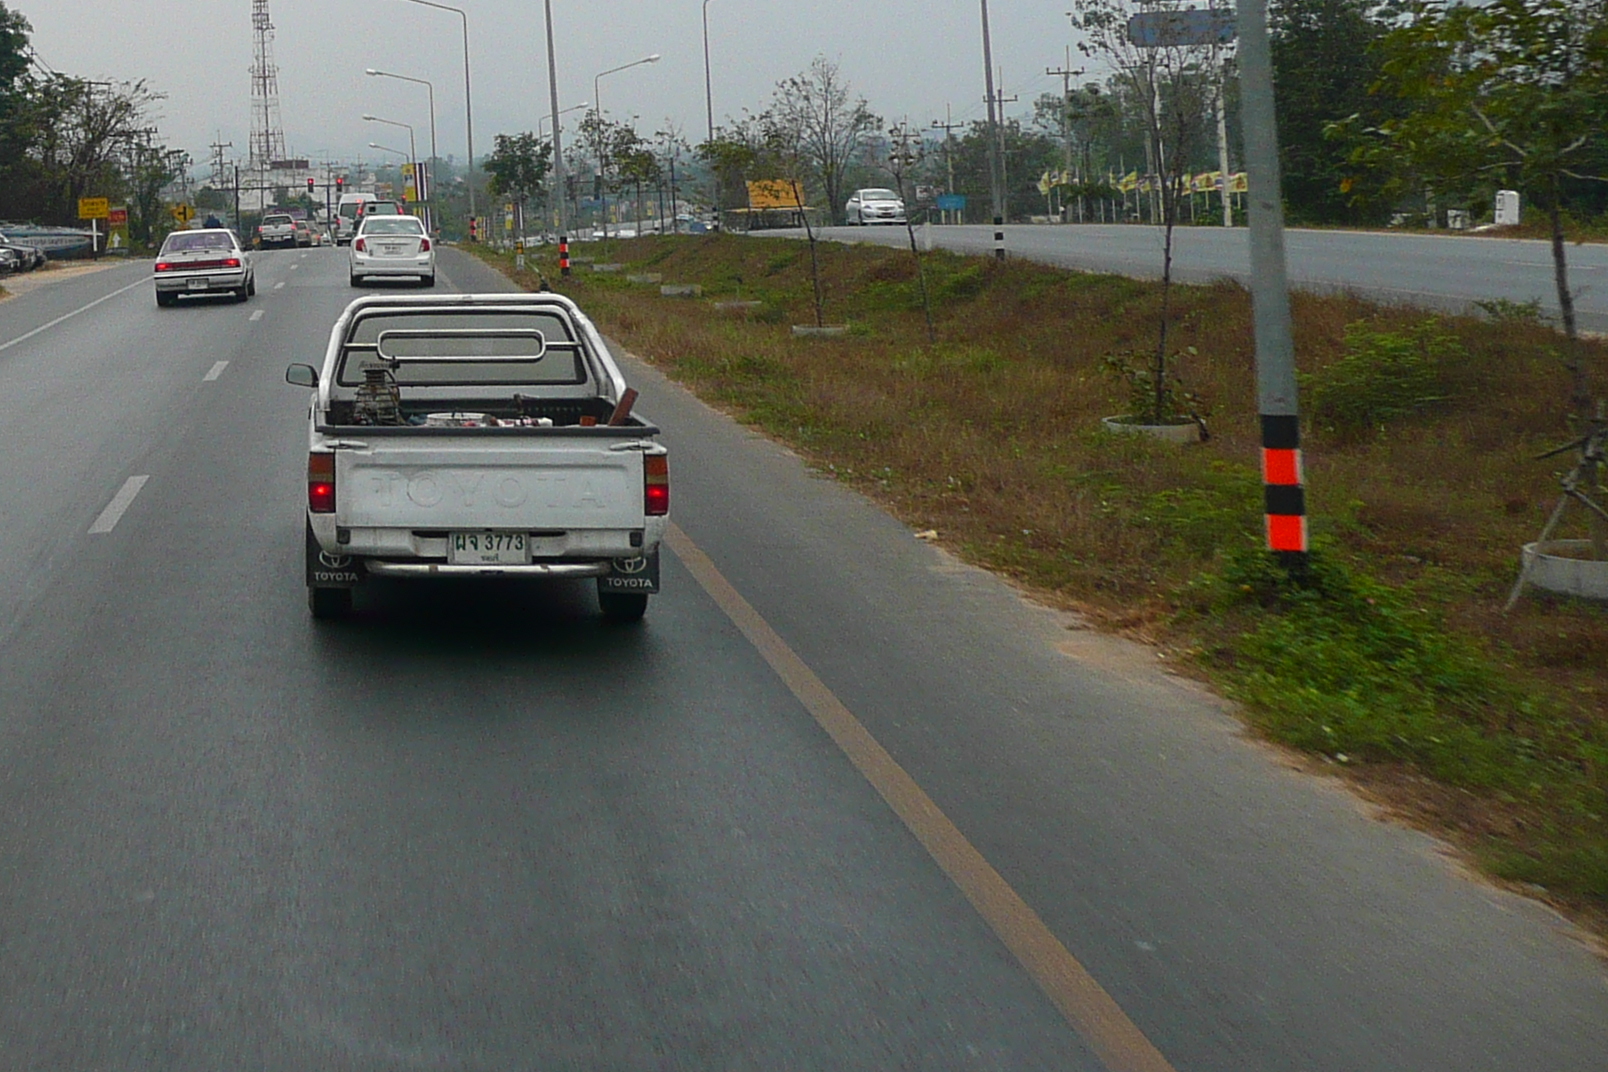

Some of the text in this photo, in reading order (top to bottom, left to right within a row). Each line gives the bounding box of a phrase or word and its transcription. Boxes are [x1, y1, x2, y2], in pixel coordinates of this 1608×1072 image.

[371, 471, 608, 508] TOYOTA
[484, 534, 524, 551] 3773
[314, 571, 359, 583] TOYOTA
[606, 577, 653, 589] TOYOTA
